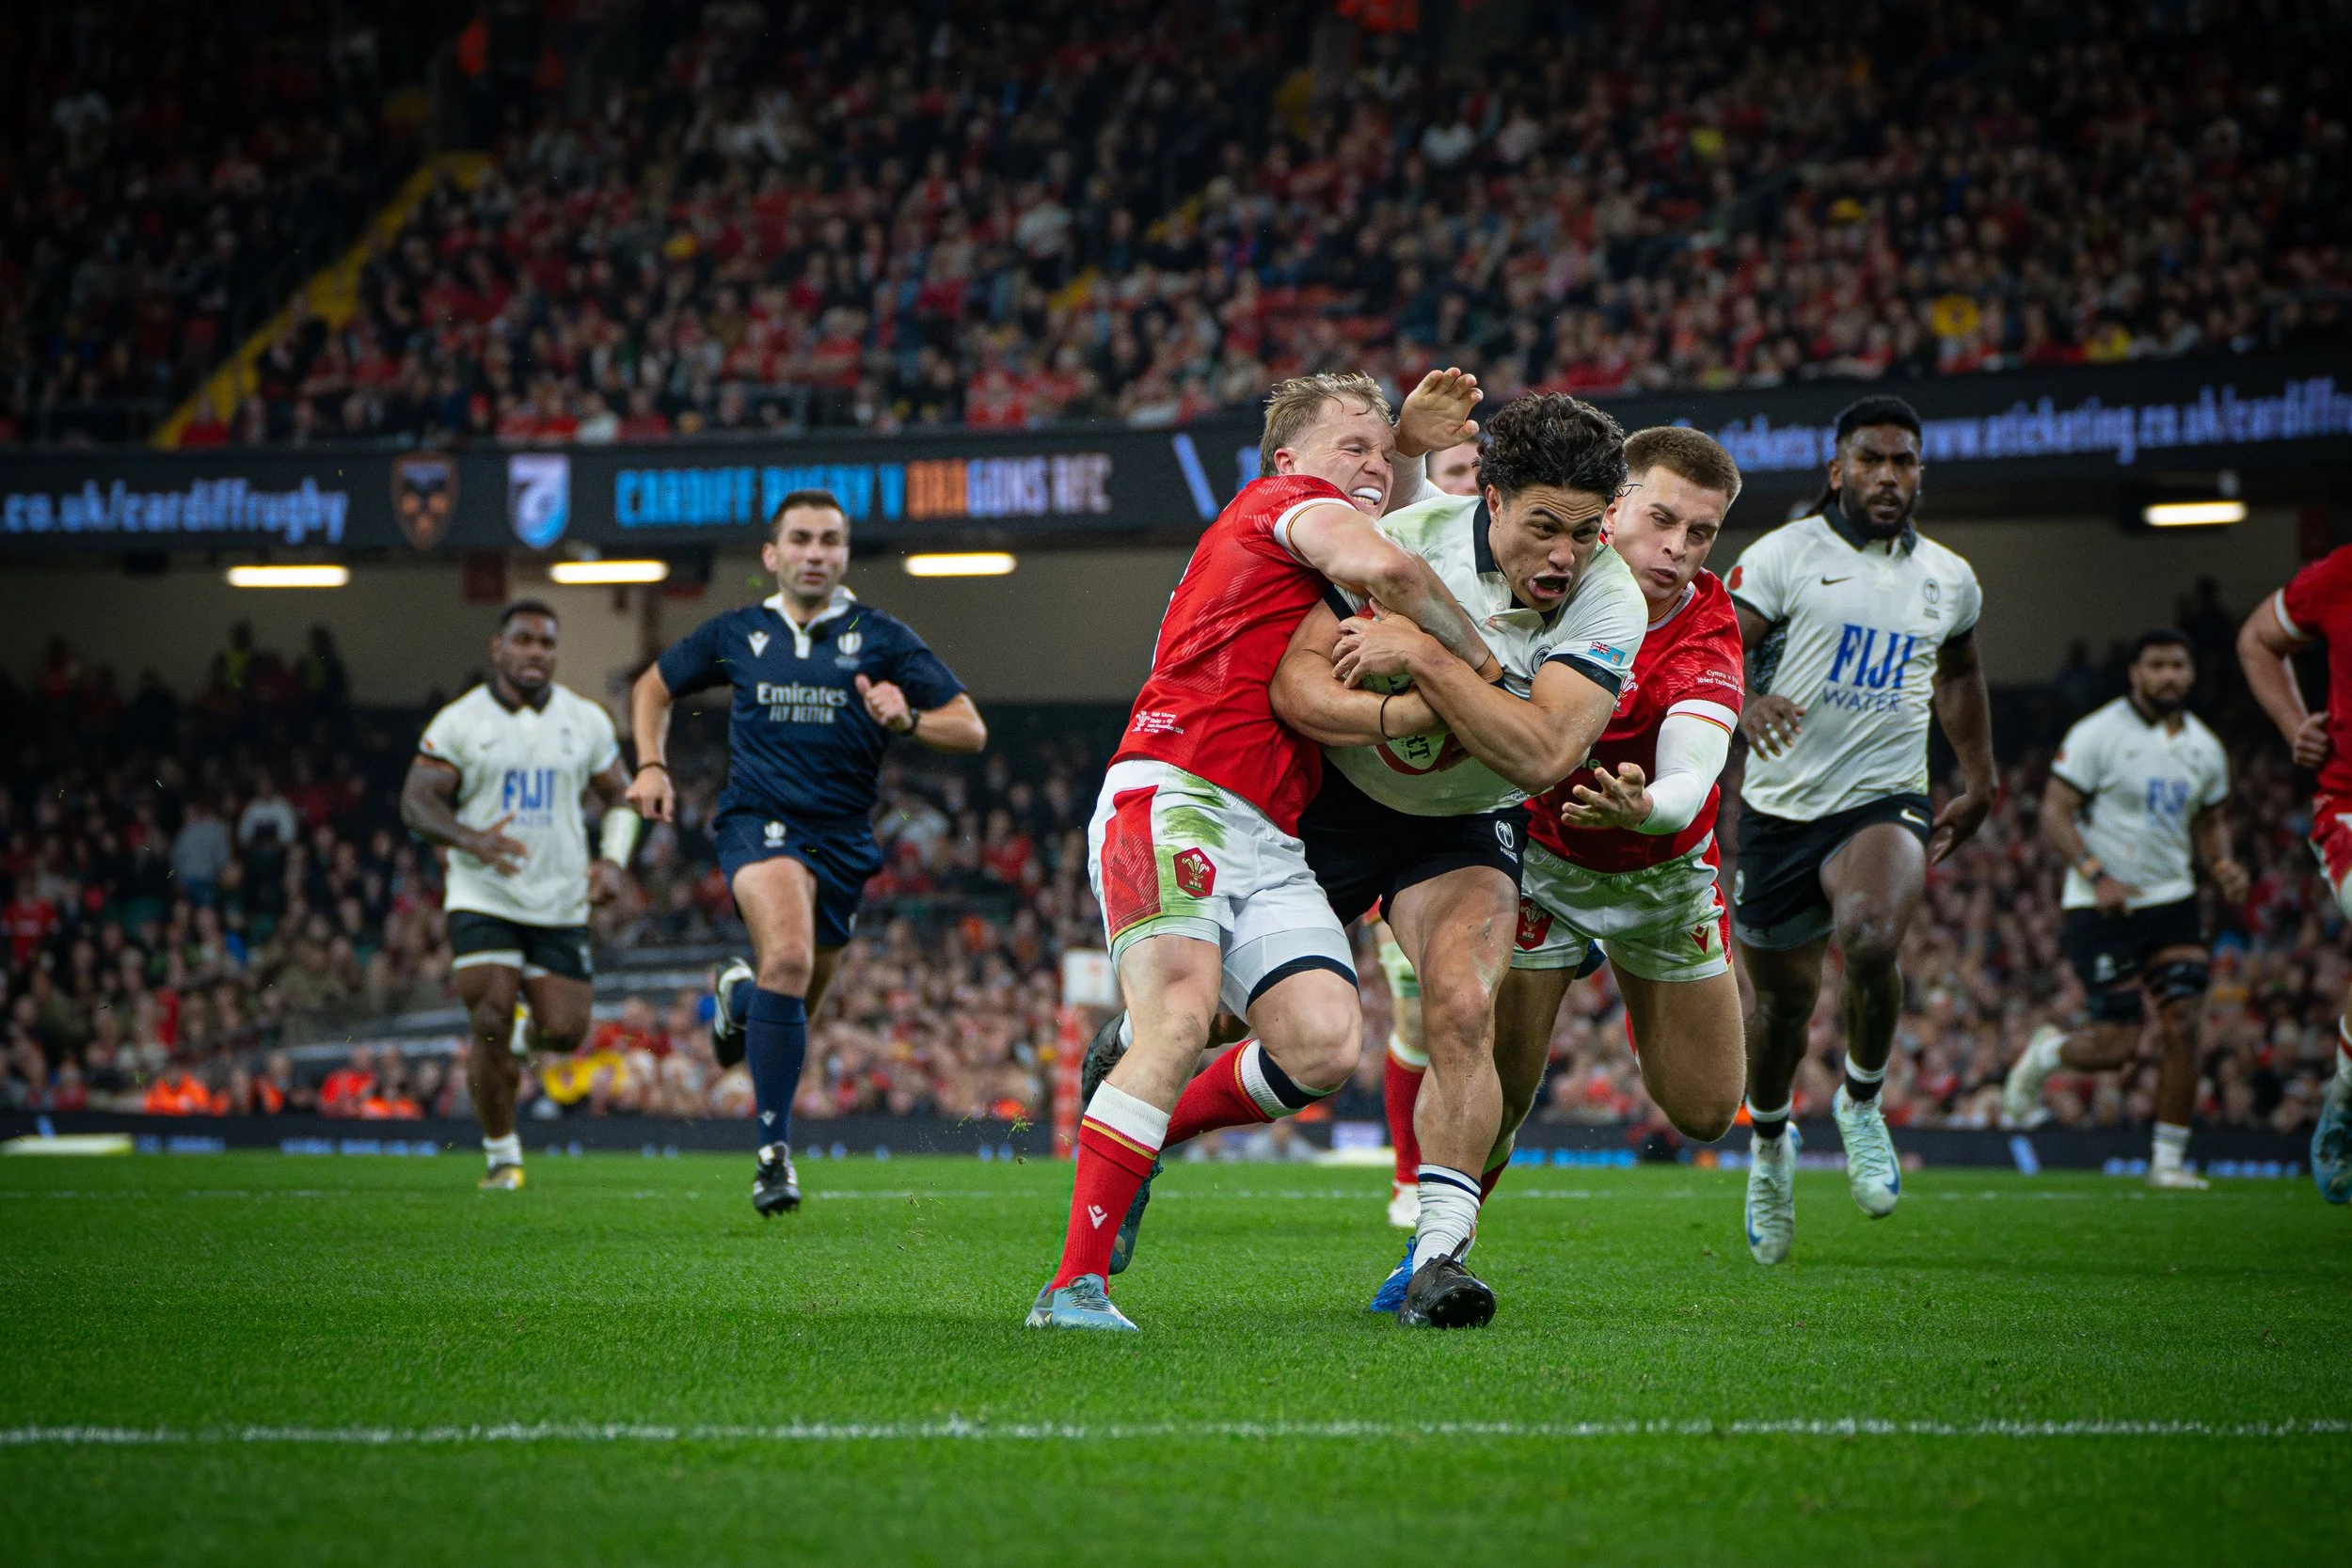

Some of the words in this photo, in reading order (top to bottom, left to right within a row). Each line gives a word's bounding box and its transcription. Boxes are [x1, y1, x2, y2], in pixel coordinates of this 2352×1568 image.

[615, 467, 754, 527] CARDIFF
[878, 462, 905, 521] V
[906, 456, 1048, 519] DRAGONS
[1828, 623, 1916, 689] FIJI
[756, 681, 848, 706] Emirates
[1822, 685, 1901, 713] WATER
[503, 768, 556, 812] FIJI
[1189, 879, 1202, 889] WRU
